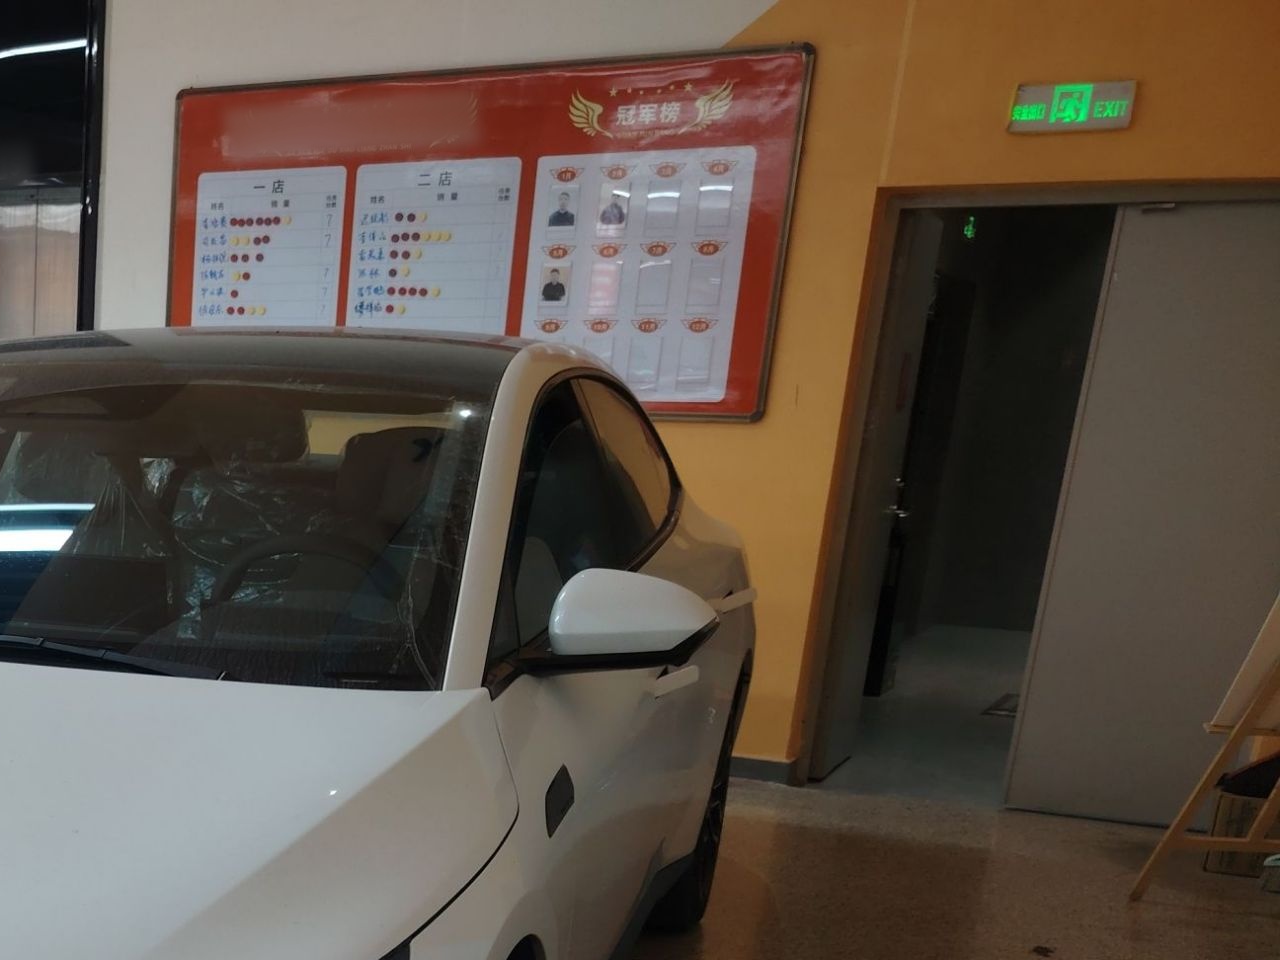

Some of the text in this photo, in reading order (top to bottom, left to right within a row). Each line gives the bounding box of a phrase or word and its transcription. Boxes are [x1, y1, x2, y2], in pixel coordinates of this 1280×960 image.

[616, 102, 681, 126] 冠军榜
[1093, 101, 1128, 118] EXIT
